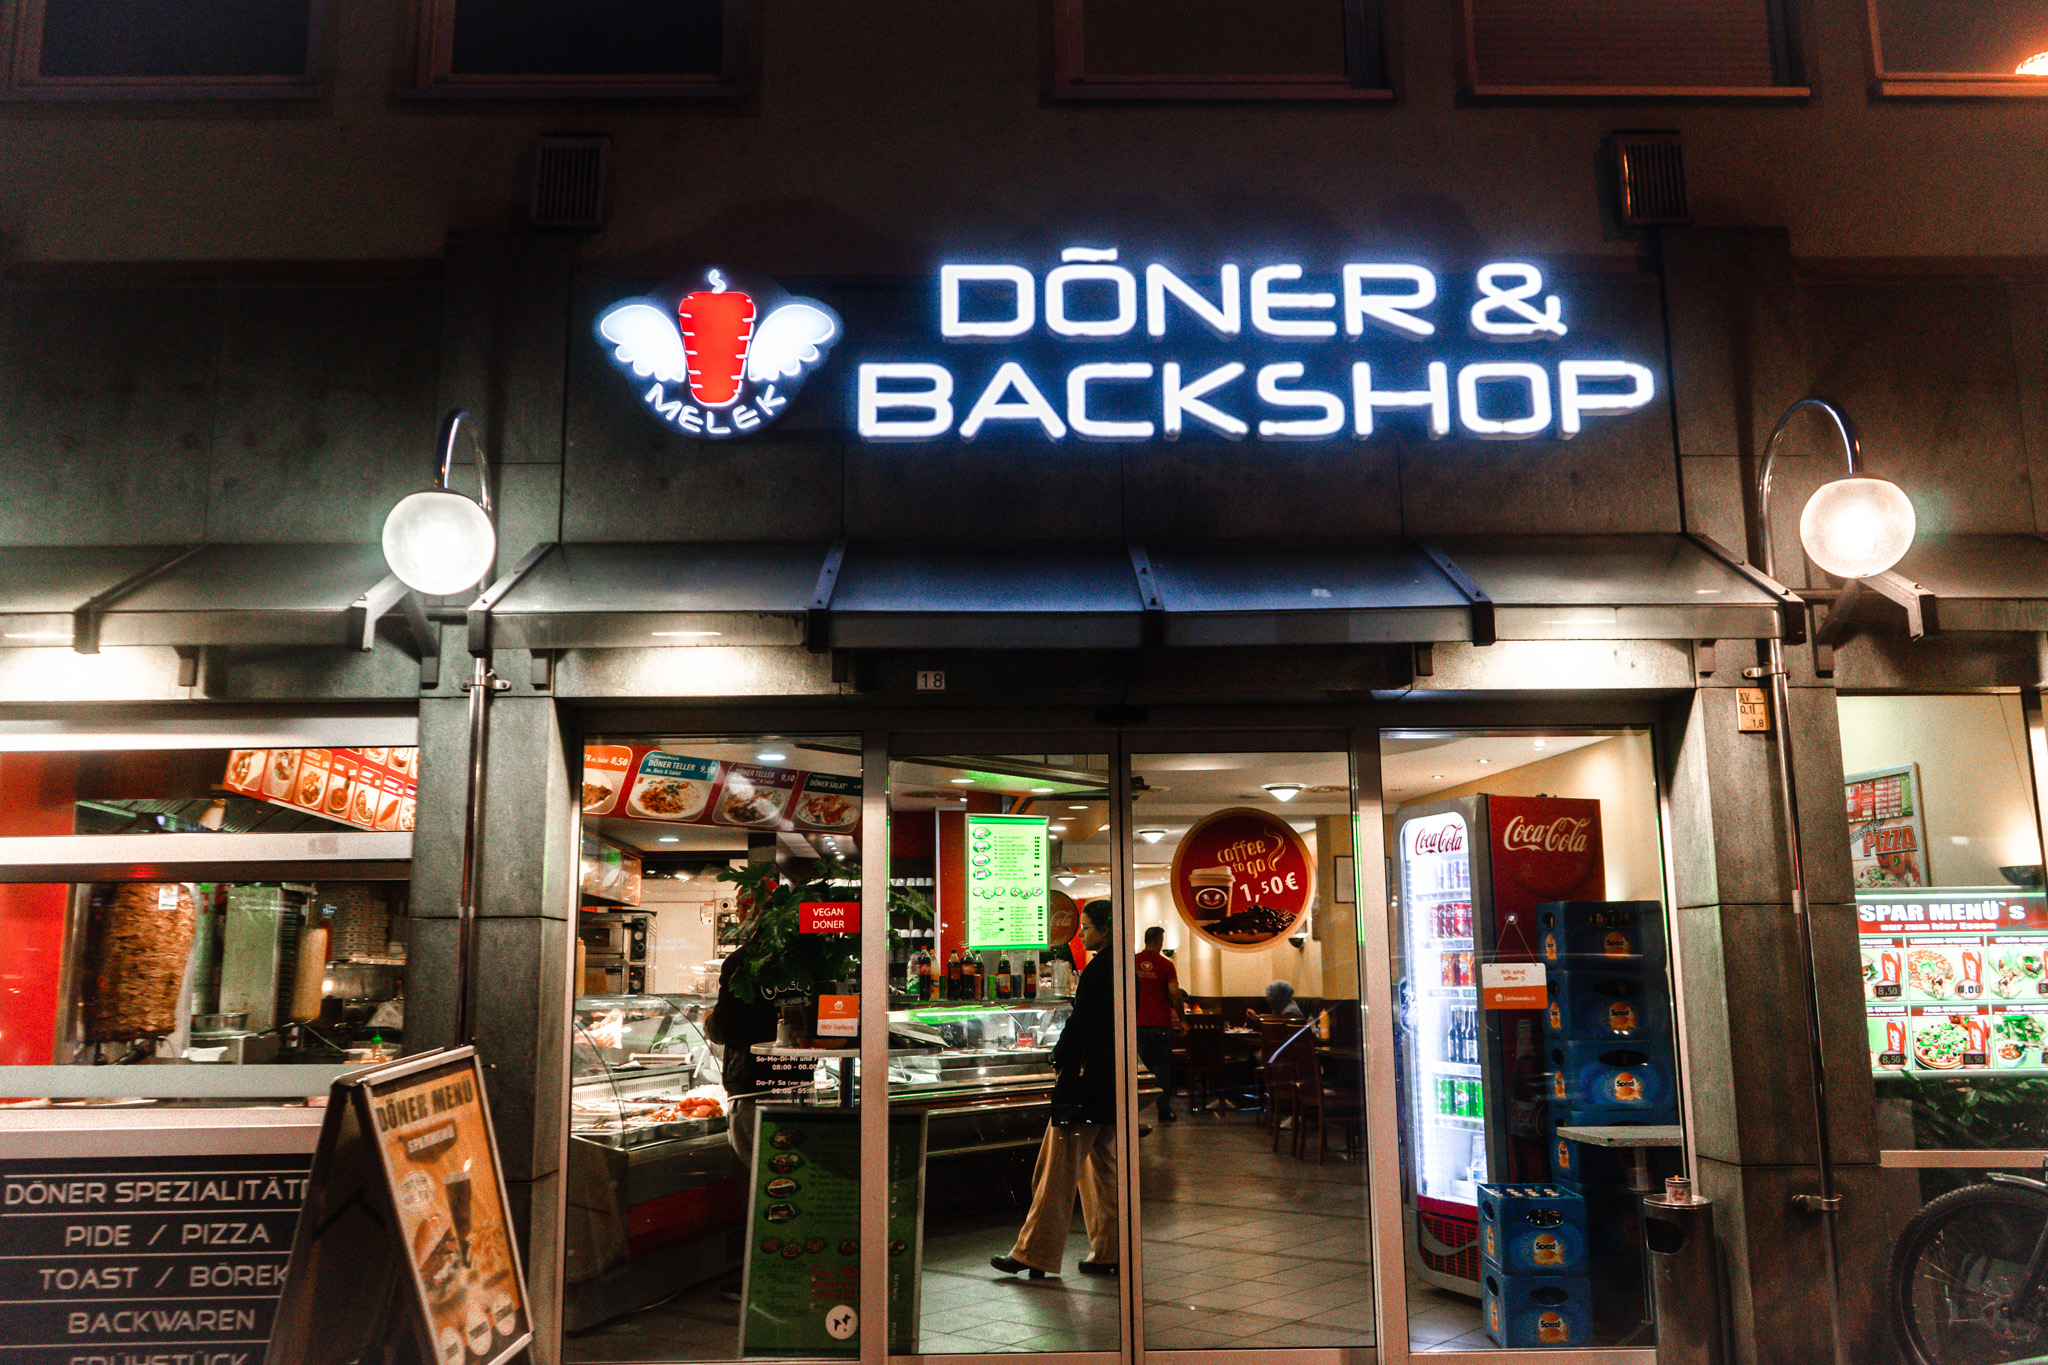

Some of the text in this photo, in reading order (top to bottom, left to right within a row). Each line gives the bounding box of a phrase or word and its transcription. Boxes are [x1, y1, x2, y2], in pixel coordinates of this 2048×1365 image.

[940, 247, 1568, 338] DÖNER &
[644, 382, 787, 434] MELEK
[858, 360, 1655, 439] BACKSHOP
[921, 672, 943, 688] 18
[610, 756, 629, 766] 8,50
[648, 758, 672, 769] DÖNER
[672, 762, 696, 771] TELLER
[755, 769, 775, 778] TELLER
[780, 773, 796, 783] 9,50
[809, 778, 829, 788] DÖNER
[1415, 823, 1464, 856] Coca-Cola
[1503, 815, 1593, 852] Coca-Cola
[1863, 825, 1918, 857] PIZZA
[1217, 839, 1266, 864] coffee
[1232, 858, 1266, 879] to go
[812, 907, 844, 917] VEGAN
[1859, 903, 1925, 923] SPAR
[1880, 923, 1904, 931] nur
[1904, 923, 1930, 931] zum
[1959, 921, 1997, 931] Essen
[1611, 1008, 1629, 1017] Spezi
[1616, 1080, 1634, 1088] Spezi
[375, 1076, 473, 1132] DÖNER MENÜ
[4, 1180, 107, 1205] DÖNER
[64, 1223, 271, 1247] PIDE / PIZZA
[1536, 1242, 1556, 1250] Spezi
[39, 1262, 289, 1290] TOAST / BÖREK
[67, 1309, 256, 1334] BACKWAREN
